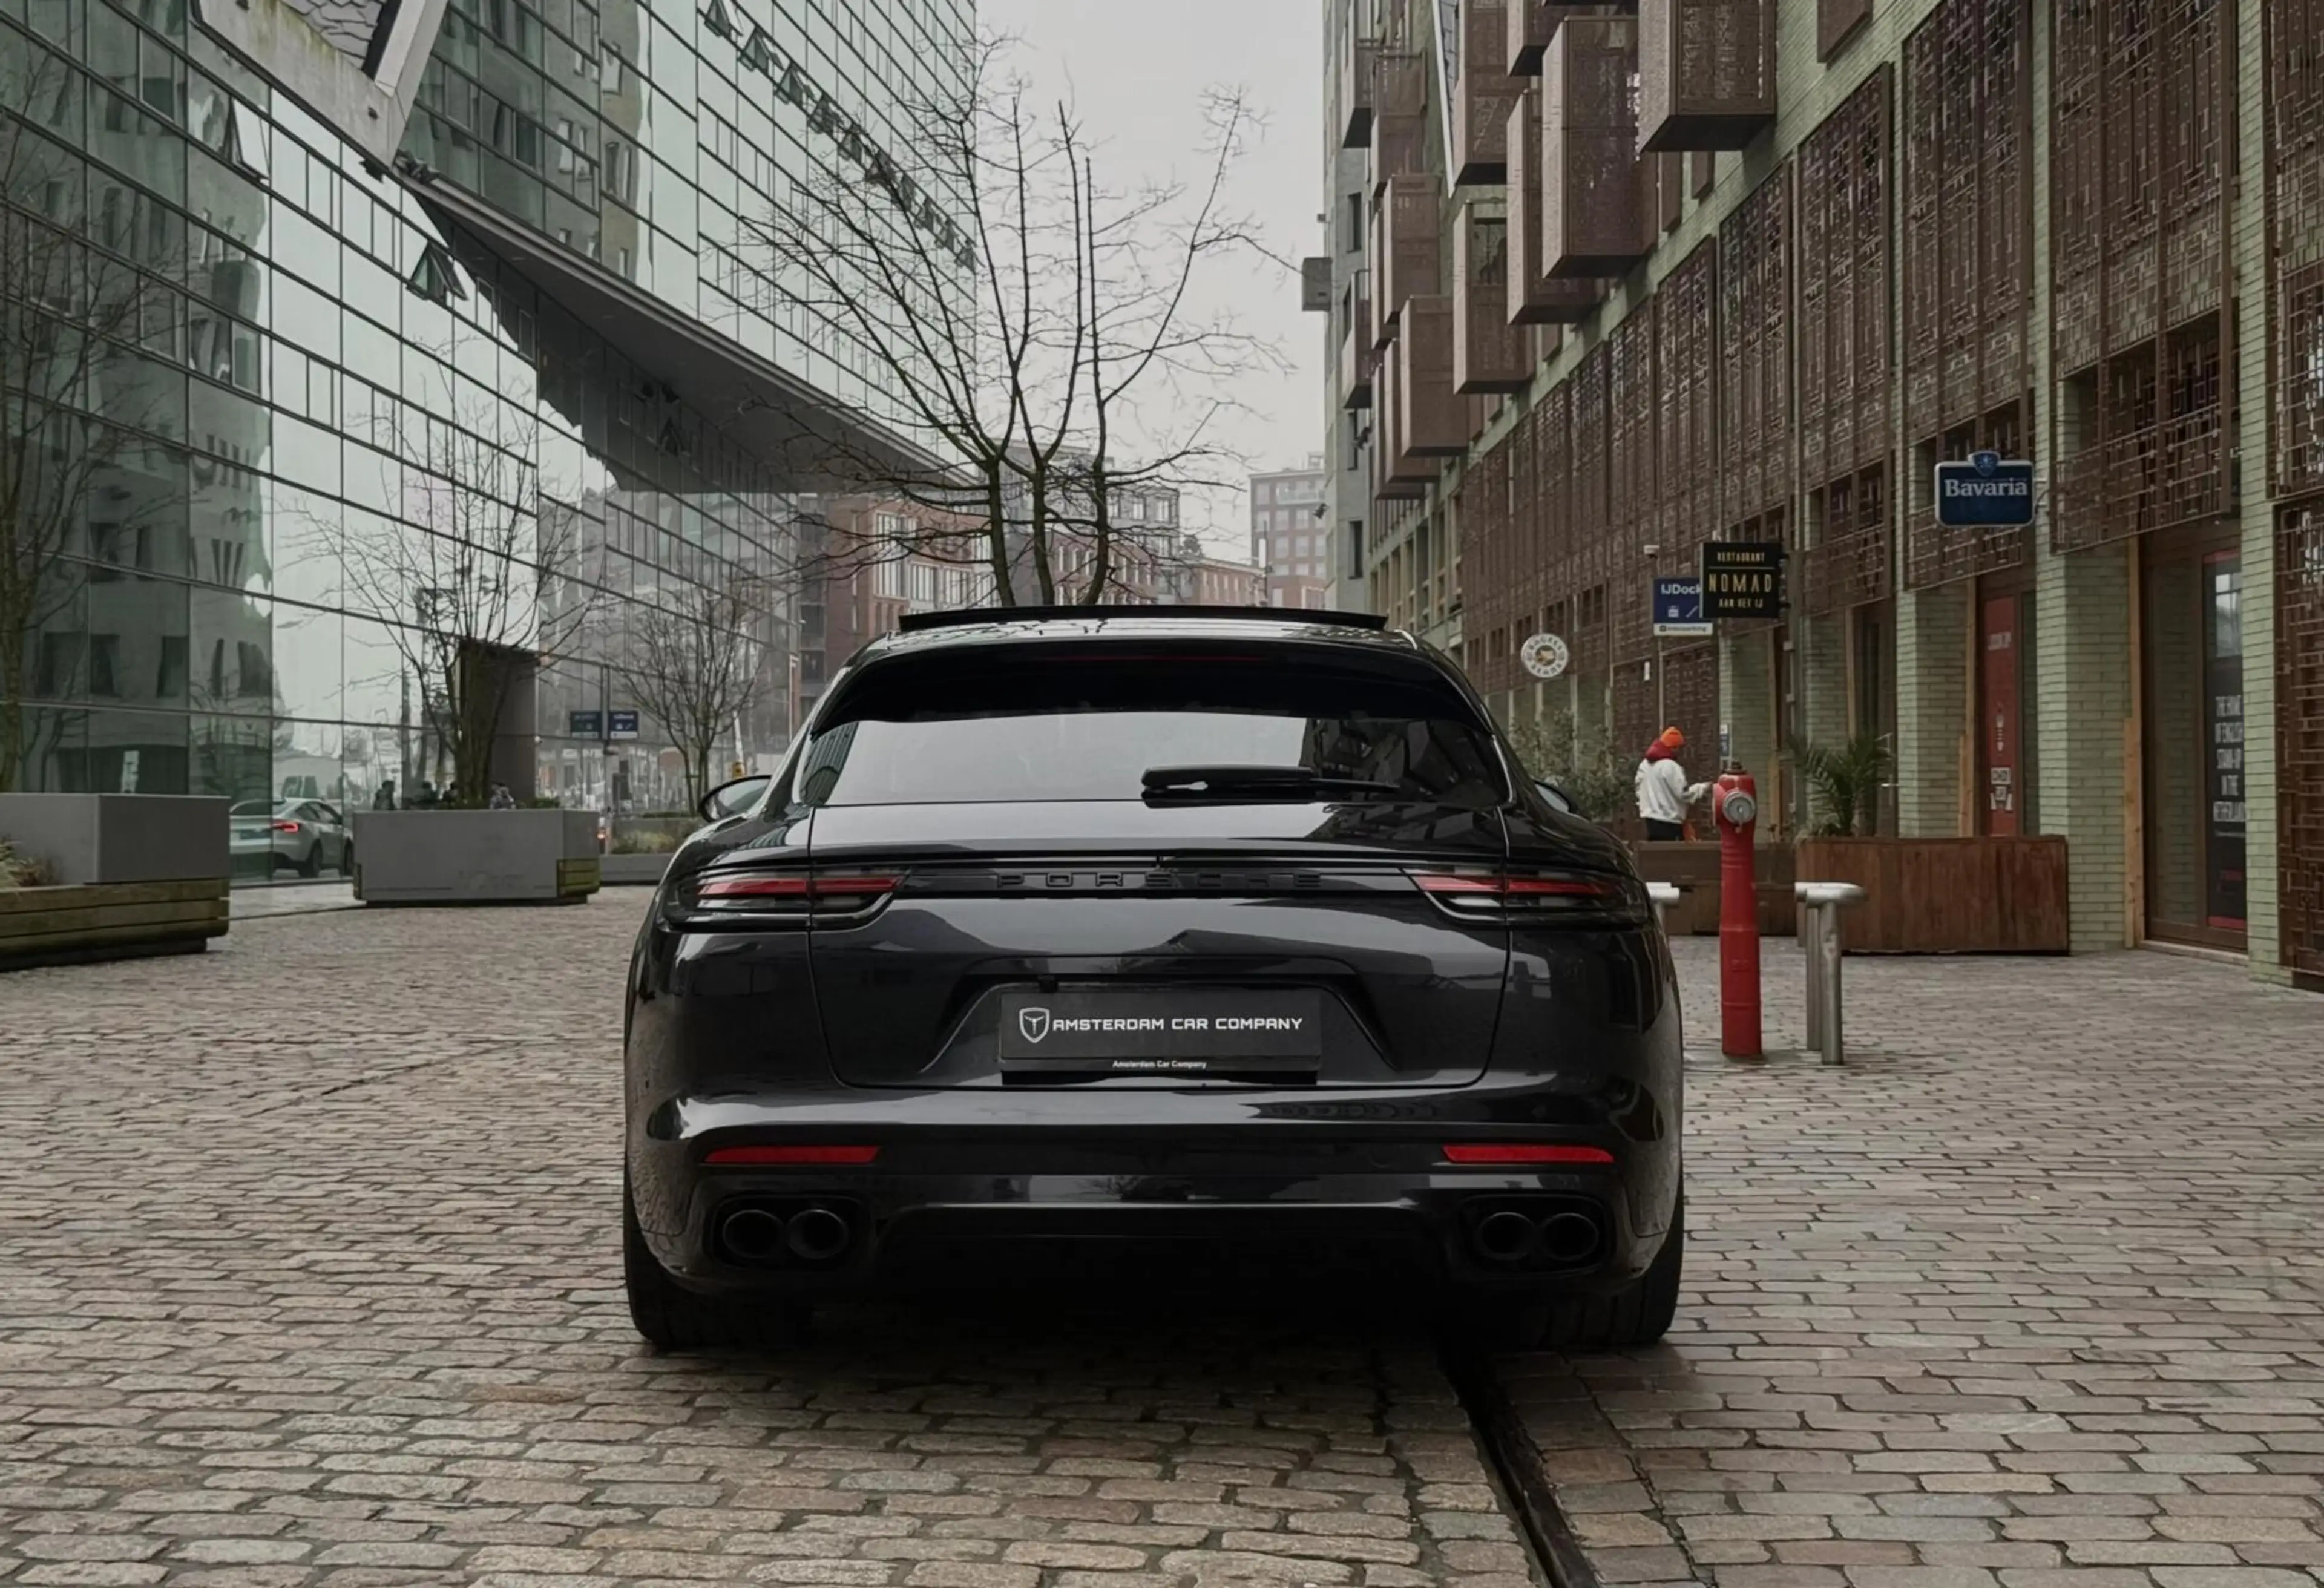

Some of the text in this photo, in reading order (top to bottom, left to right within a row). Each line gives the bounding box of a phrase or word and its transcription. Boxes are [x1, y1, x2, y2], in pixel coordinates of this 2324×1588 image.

[1945, 477, 2029, 497] Bavaria
[1717, 551, 1765, 563] RESTAURANT
[1709, 573, 1772, 593] NOMAD
[997, 872, 1321, 888] PORSCHE
[1052, 1017, 1303, 1031] AMSTERDAM CAR COMPANY
[1172, 1060, 1207, 1069] Company
